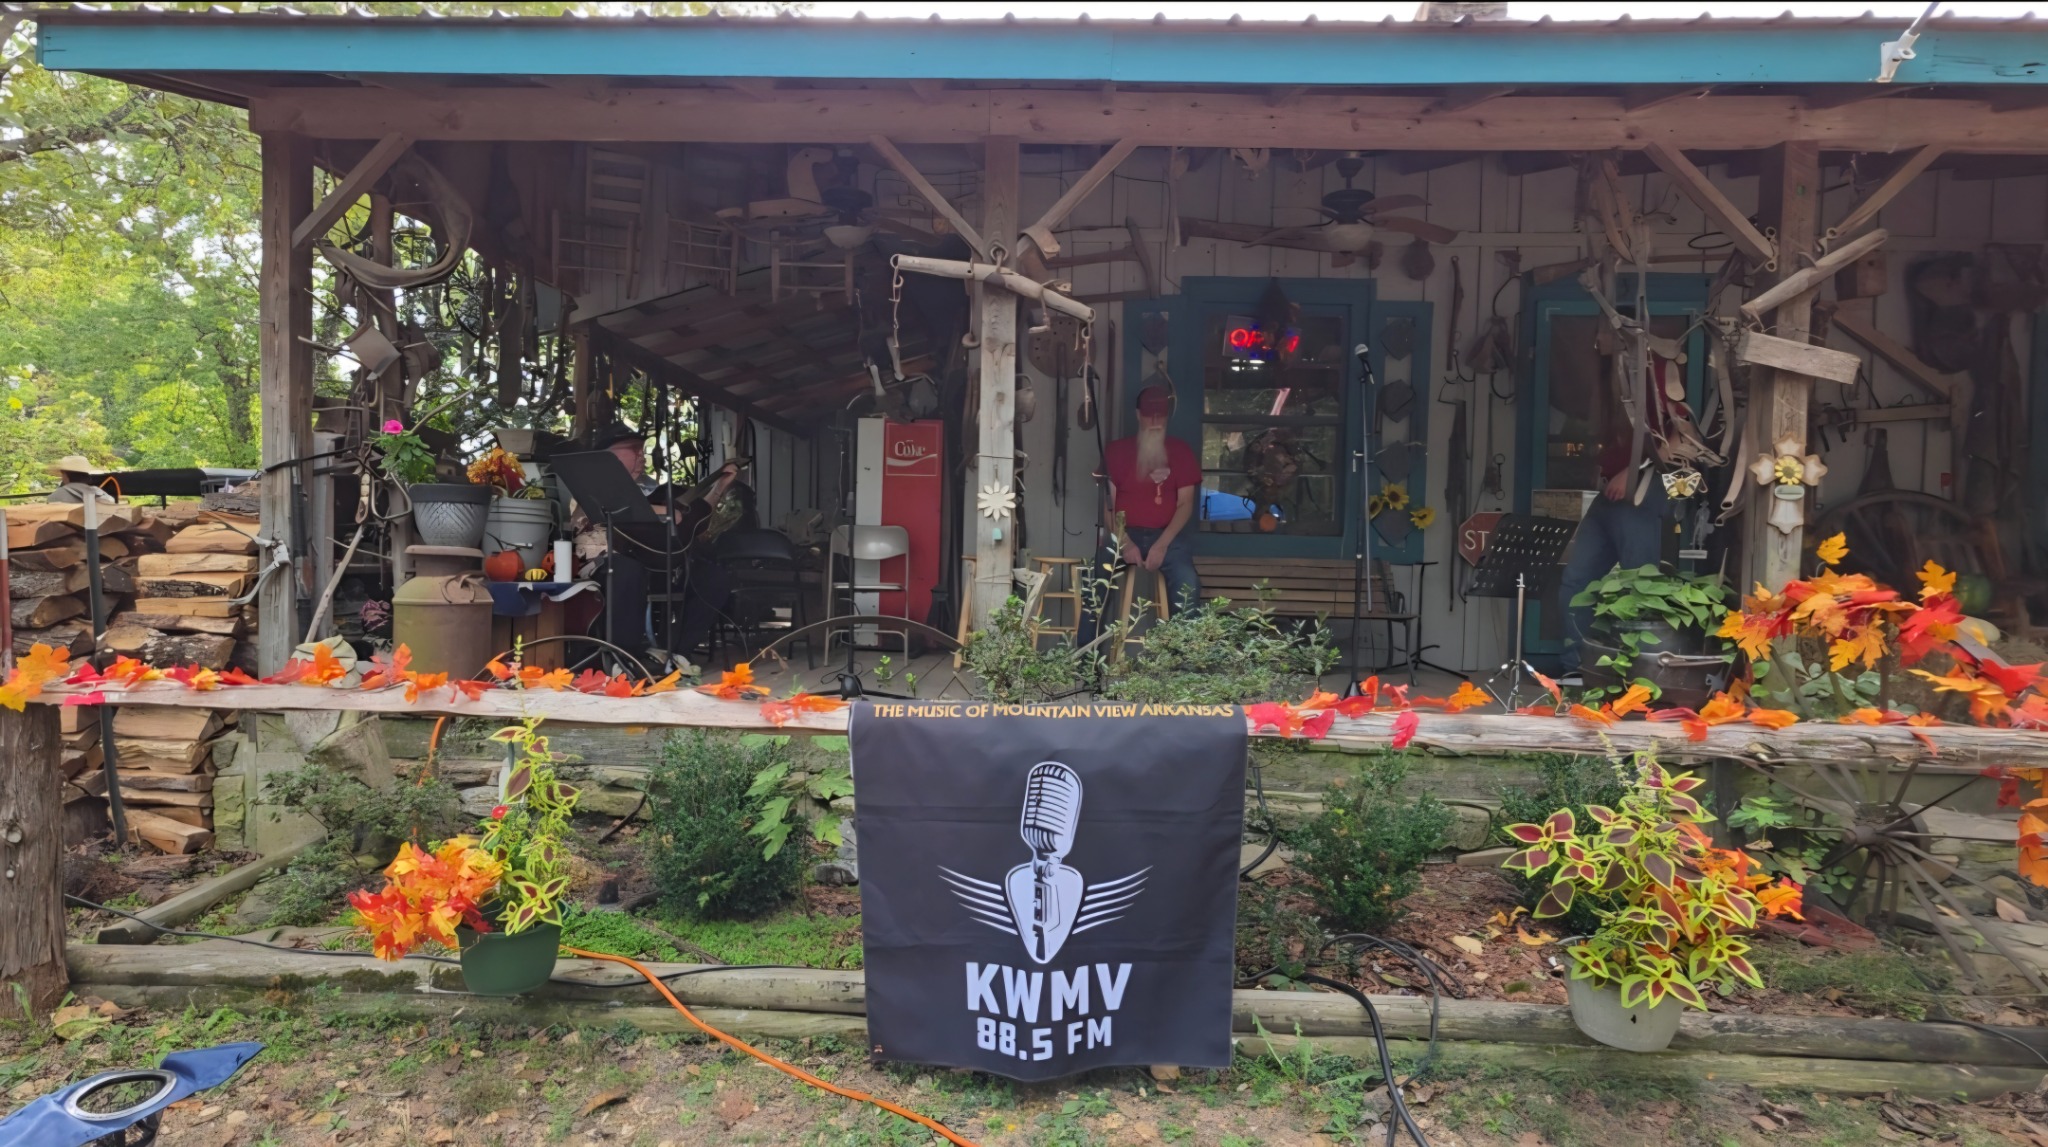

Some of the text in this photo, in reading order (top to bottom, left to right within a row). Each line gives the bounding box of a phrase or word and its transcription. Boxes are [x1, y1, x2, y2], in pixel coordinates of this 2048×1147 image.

[1229, 327, 1300, 352] OP
[894, 439, 926, 457] Coke
[1464, 530, 1490, 551] ST
[873, 703, 1234, 718] THE MUSIC OF MOUNTAIN VIEW ARKANSAS
[966, 961, 1133, 1023] KWMV
[977, 1016, 1112, 1061] 88.5 FM
